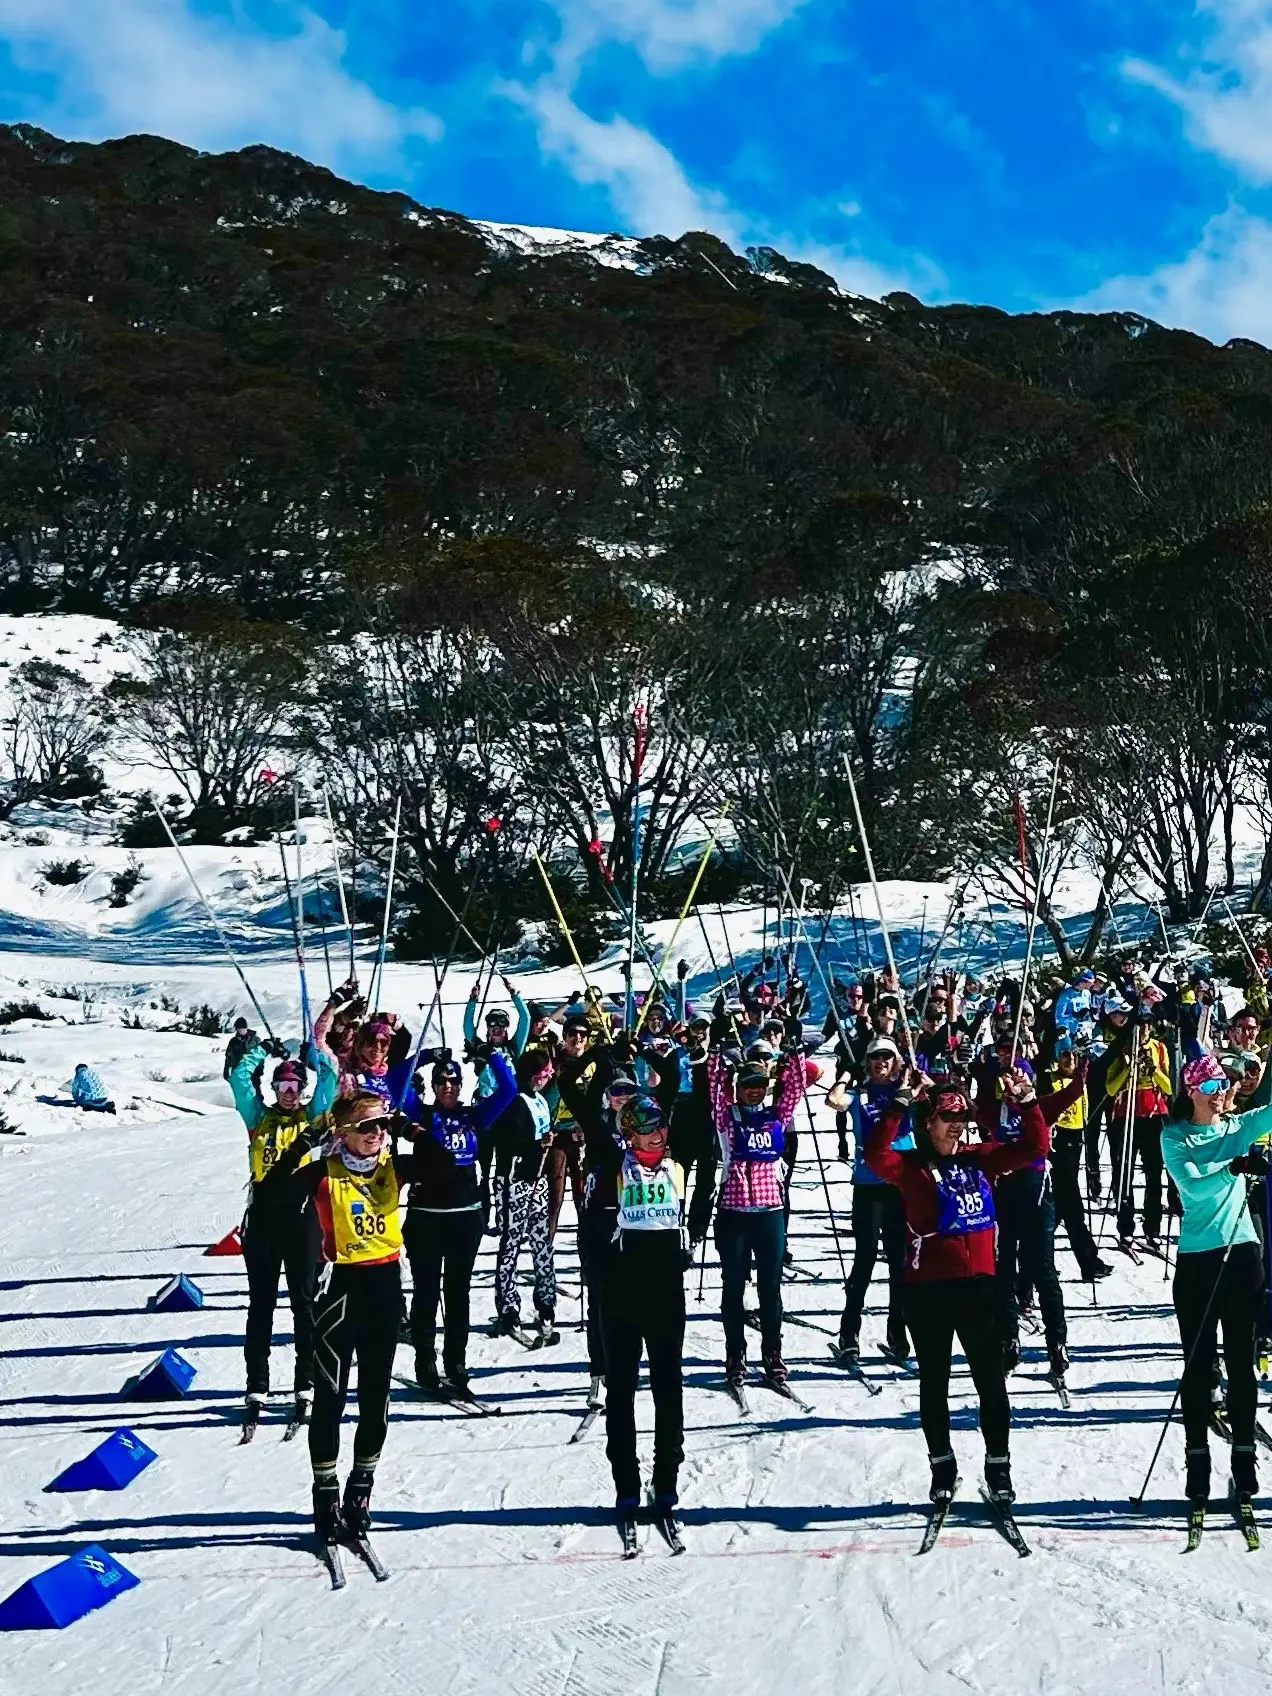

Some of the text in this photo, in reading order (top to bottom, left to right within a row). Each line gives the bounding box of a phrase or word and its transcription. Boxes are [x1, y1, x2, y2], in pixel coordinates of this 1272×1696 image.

[748, 1132, 772, 1149] 400
[956, 1191, 984, 1215] 385
[354, 1213, 386, 1236] 836
